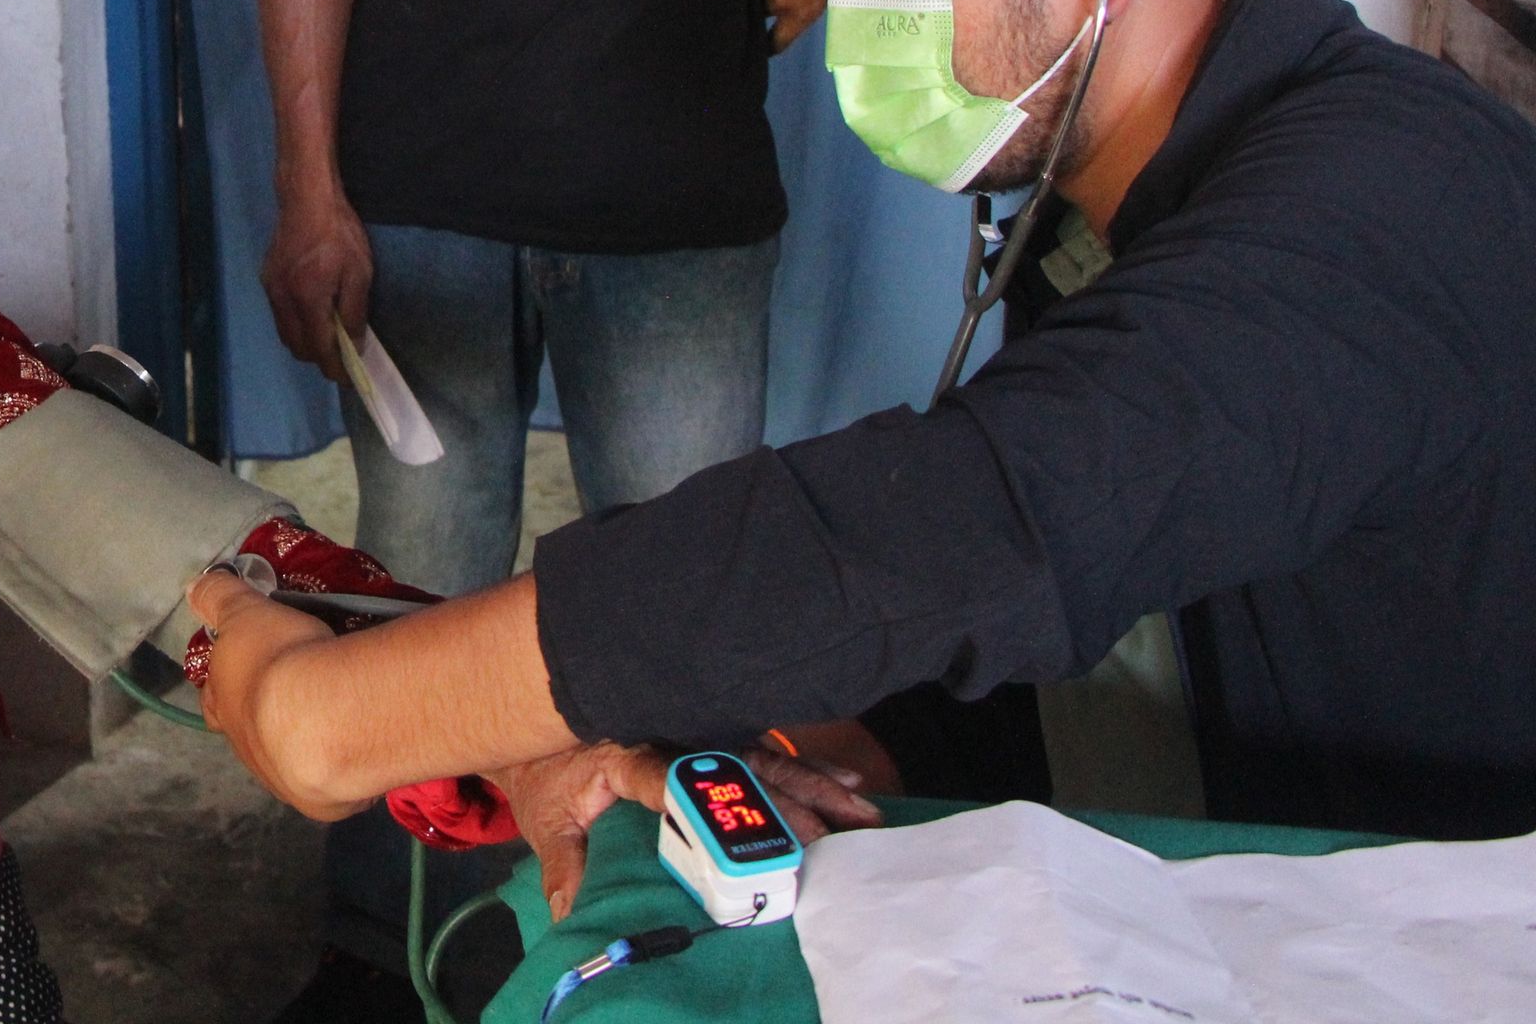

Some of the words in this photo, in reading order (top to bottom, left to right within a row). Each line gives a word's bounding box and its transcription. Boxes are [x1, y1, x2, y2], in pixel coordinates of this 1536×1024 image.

[876, 15, 921, 35] AURA
[709, 782, 745, 803] 100
[730, 836, 787, 854] OXIMETER
